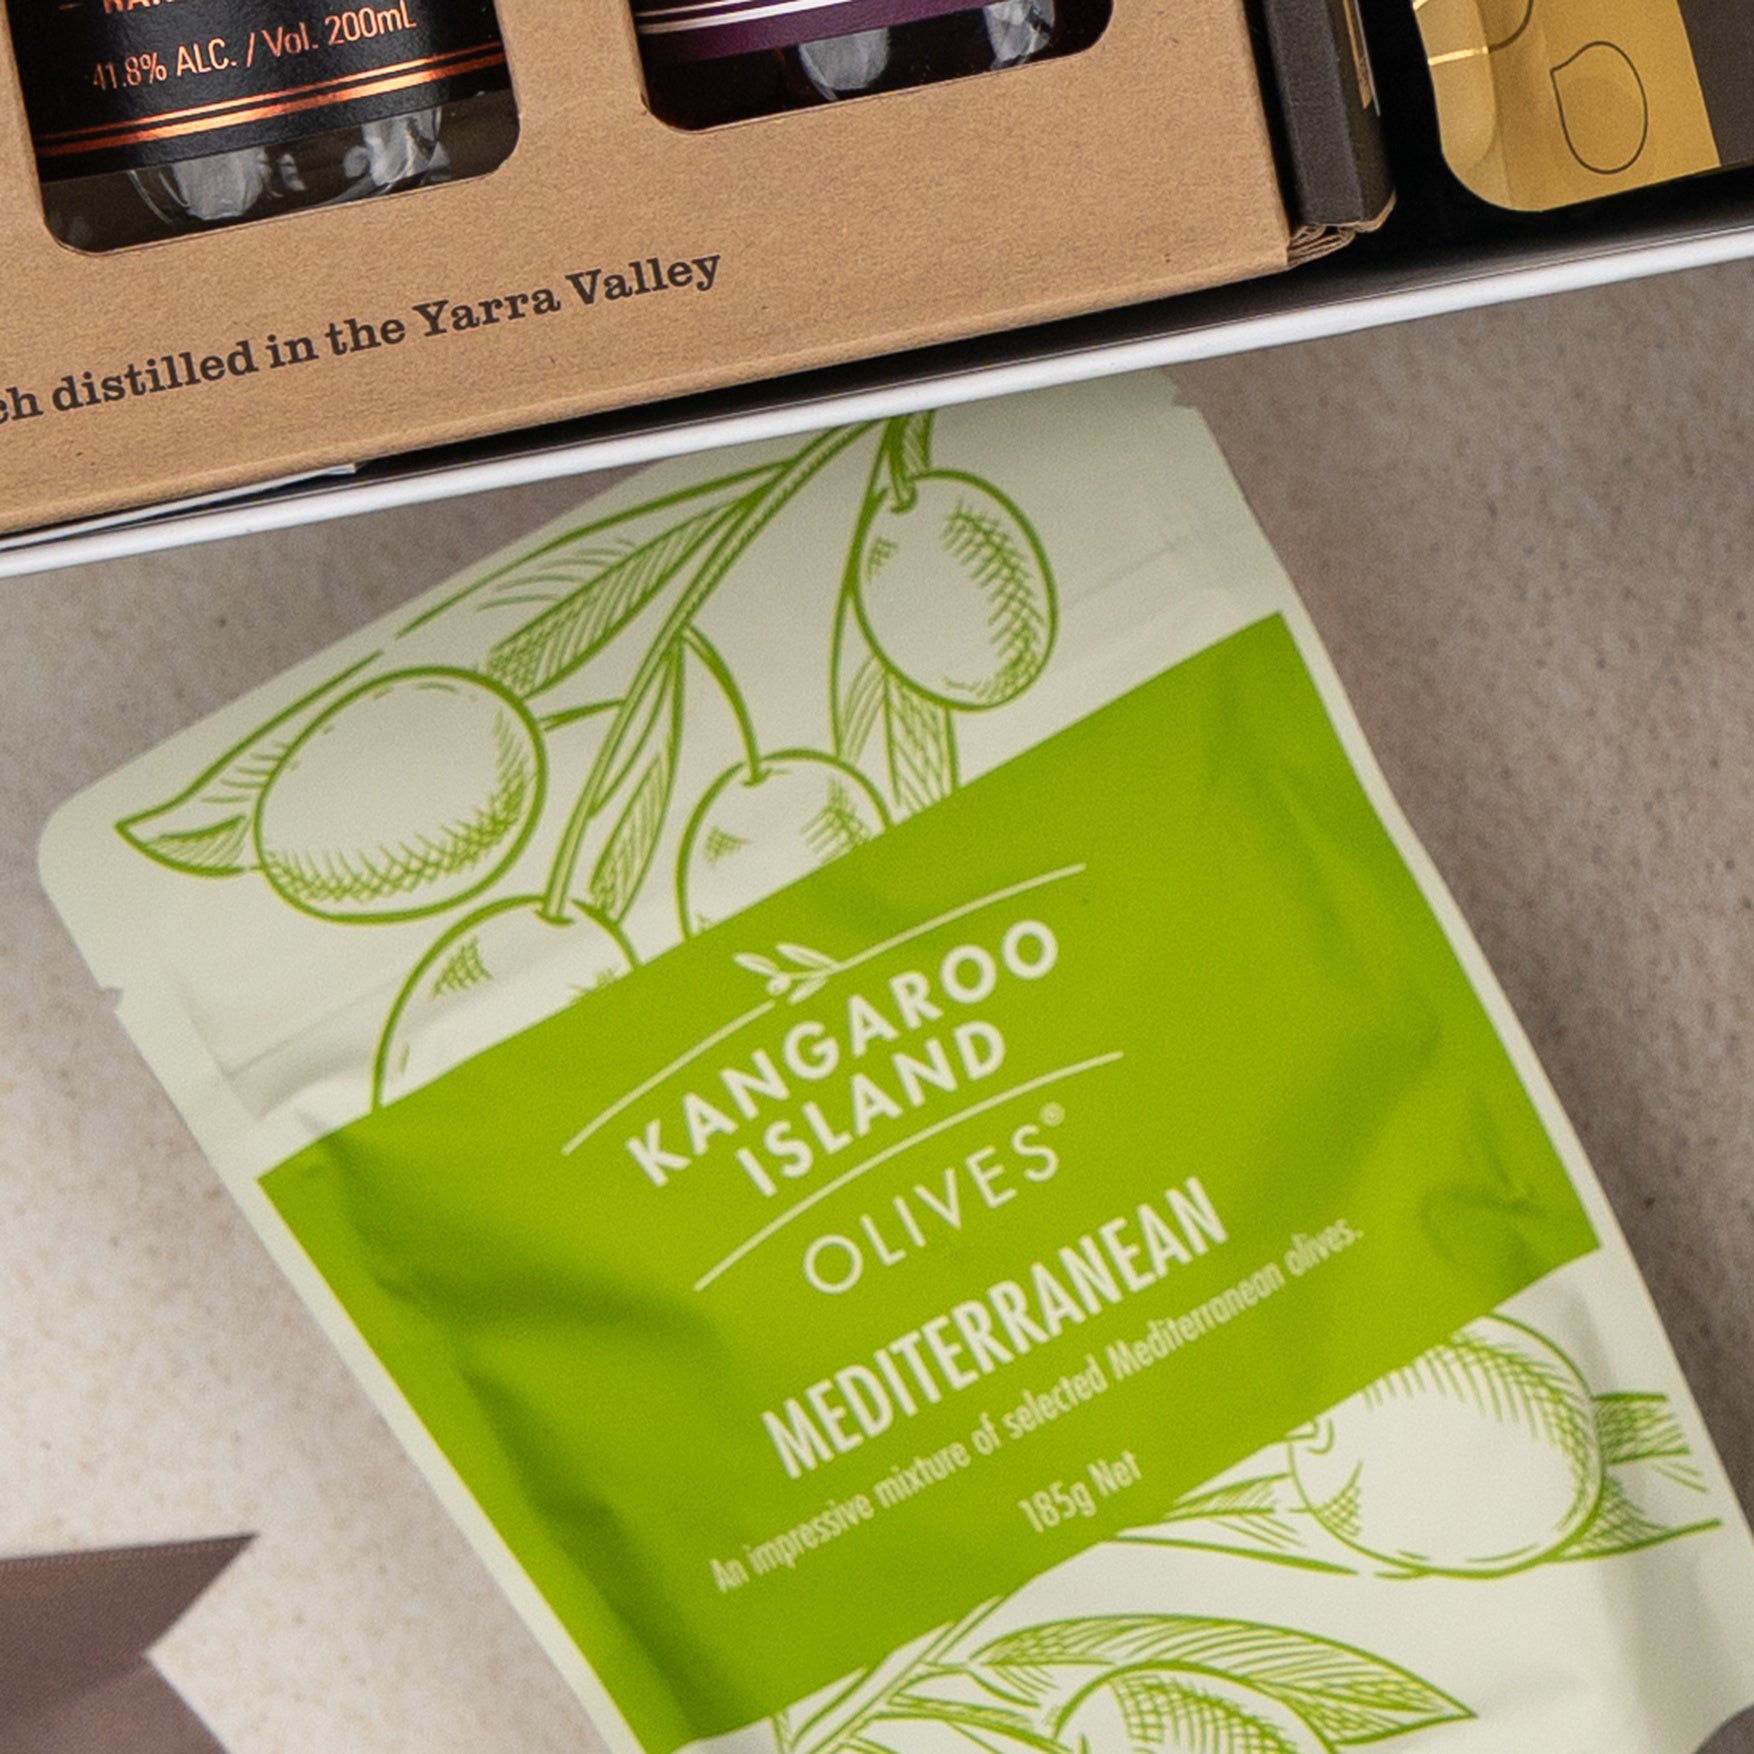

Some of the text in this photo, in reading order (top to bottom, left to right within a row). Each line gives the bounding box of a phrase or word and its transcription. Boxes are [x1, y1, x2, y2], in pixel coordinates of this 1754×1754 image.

[93, 52, 167, 91] 41.8%
[176, 37, 237, 76] ALC.
[324, 0, 417, 46] 200mL
[51, 339, 259, 412] distilled
[265, 334, 320, 369] in
[324, 318, 406, 356] the
[411, 288, 562, 337] Yarra
[565, 254, 721, 305] Valley
[625, 919, 1059, 1188] KANGAROO
[735, 1020, 1006, 1198] ISLAND
[709, 1217, 1364, 1594] An impressive mixture of selected Mediterranean olives.
[761, 1176, 1229, 1480] MEDITERRANEAN
[1018, 1449, 1142, 1534] 185g Net
